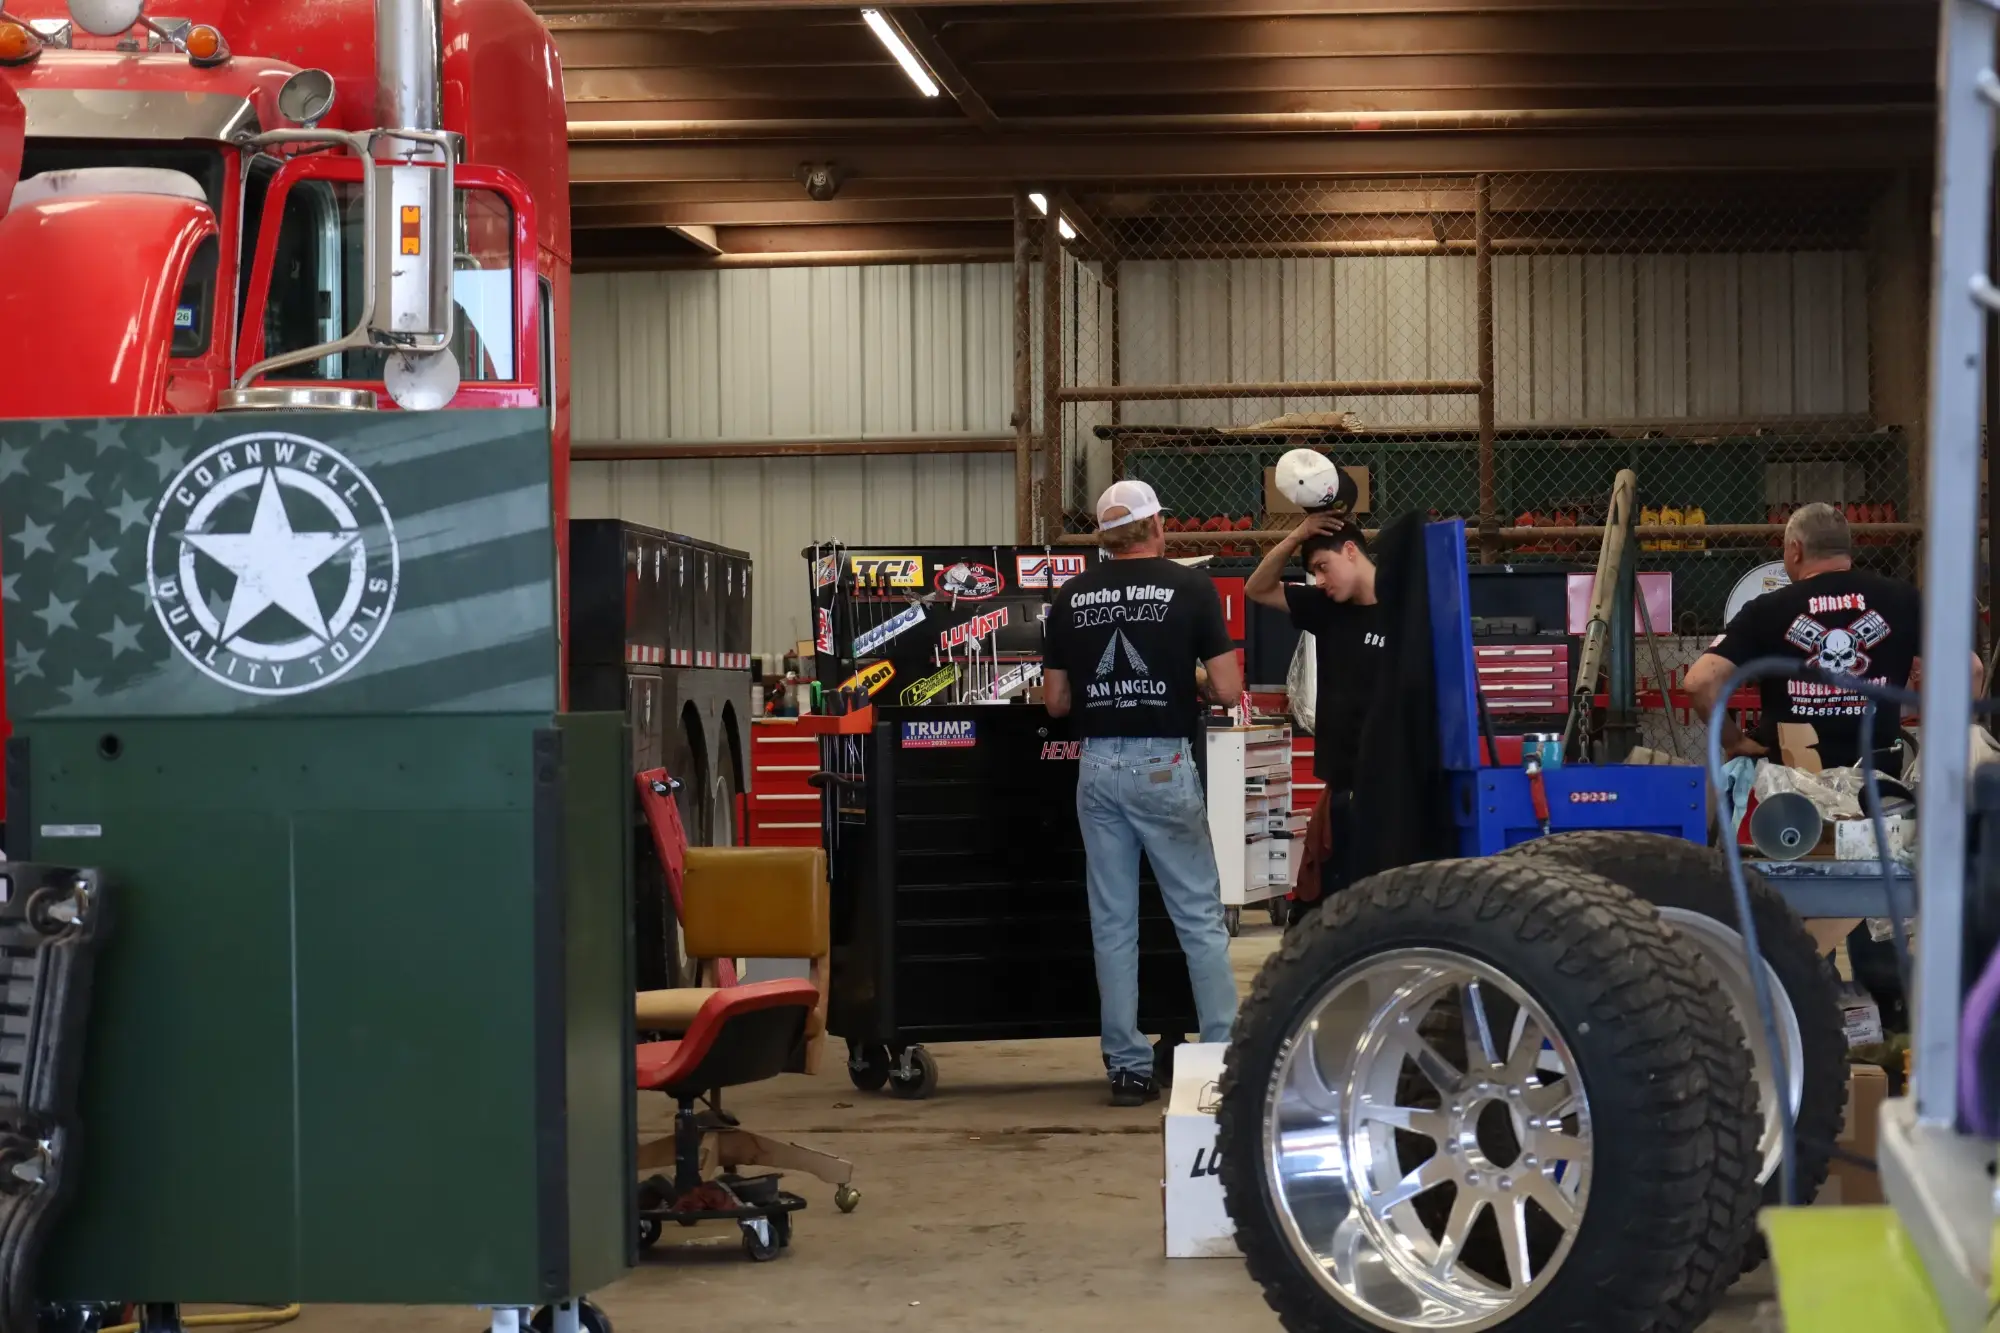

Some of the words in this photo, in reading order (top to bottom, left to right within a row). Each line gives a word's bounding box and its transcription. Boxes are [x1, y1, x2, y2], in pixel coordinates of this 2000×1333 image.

[177, 312, 190, 321] 26
[175, 442, 362, 507] CORNWELL
[856, 560, 914, 577] TCI
[1071, 588, 1121, 608] Concho
[1126, 585, 1174, 602] Valley
[1808, 593, 1866, 614] CHRIS'S
[1073, 603, 1169, 628] DRAGWAY
[158, 580, 285, 685] QUALITY
[309, 577, 389, 675] TOOLS
[941, 606, 1009, 650] LUNATI
[1087, 682, 1111, 698] SAN
[1114, 680, 1167, 695] ANGELO
[1788, 678, 1832, 696] DIESEL
[1114, 697, 1137, 708] Texas
[908, 721, 972, 735] TRUMP
[1041, 741, 1082, 759] HEND
